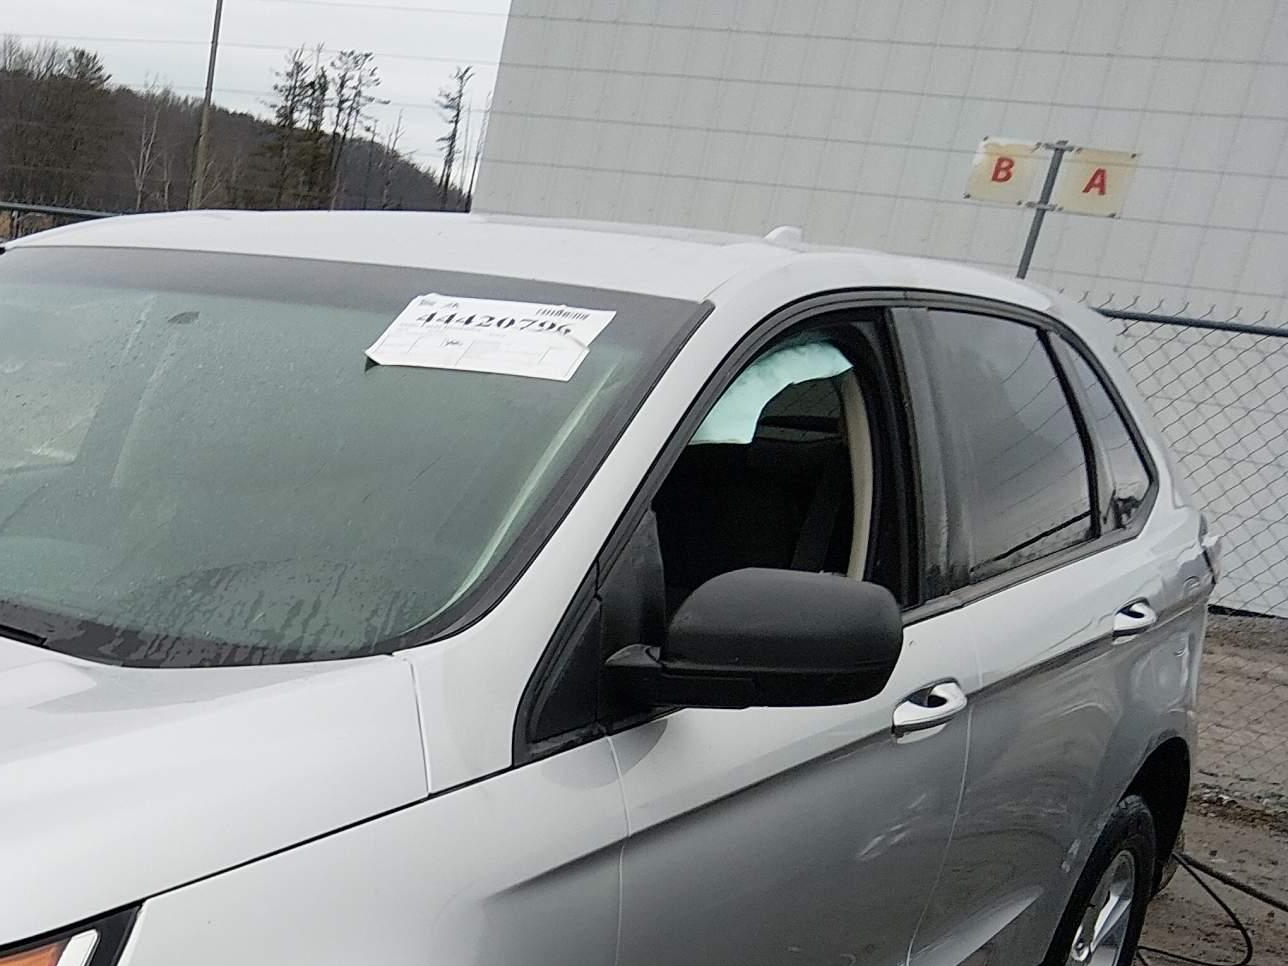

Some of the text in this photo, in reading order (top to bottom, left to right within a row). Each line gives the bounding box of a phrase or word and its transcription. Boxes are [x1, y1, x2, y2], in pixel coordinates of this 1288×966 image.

[991, 156, 1015, 183] B
[1081, 168, 1108, 196] A
[416, 311, 572, 335] 44420796
